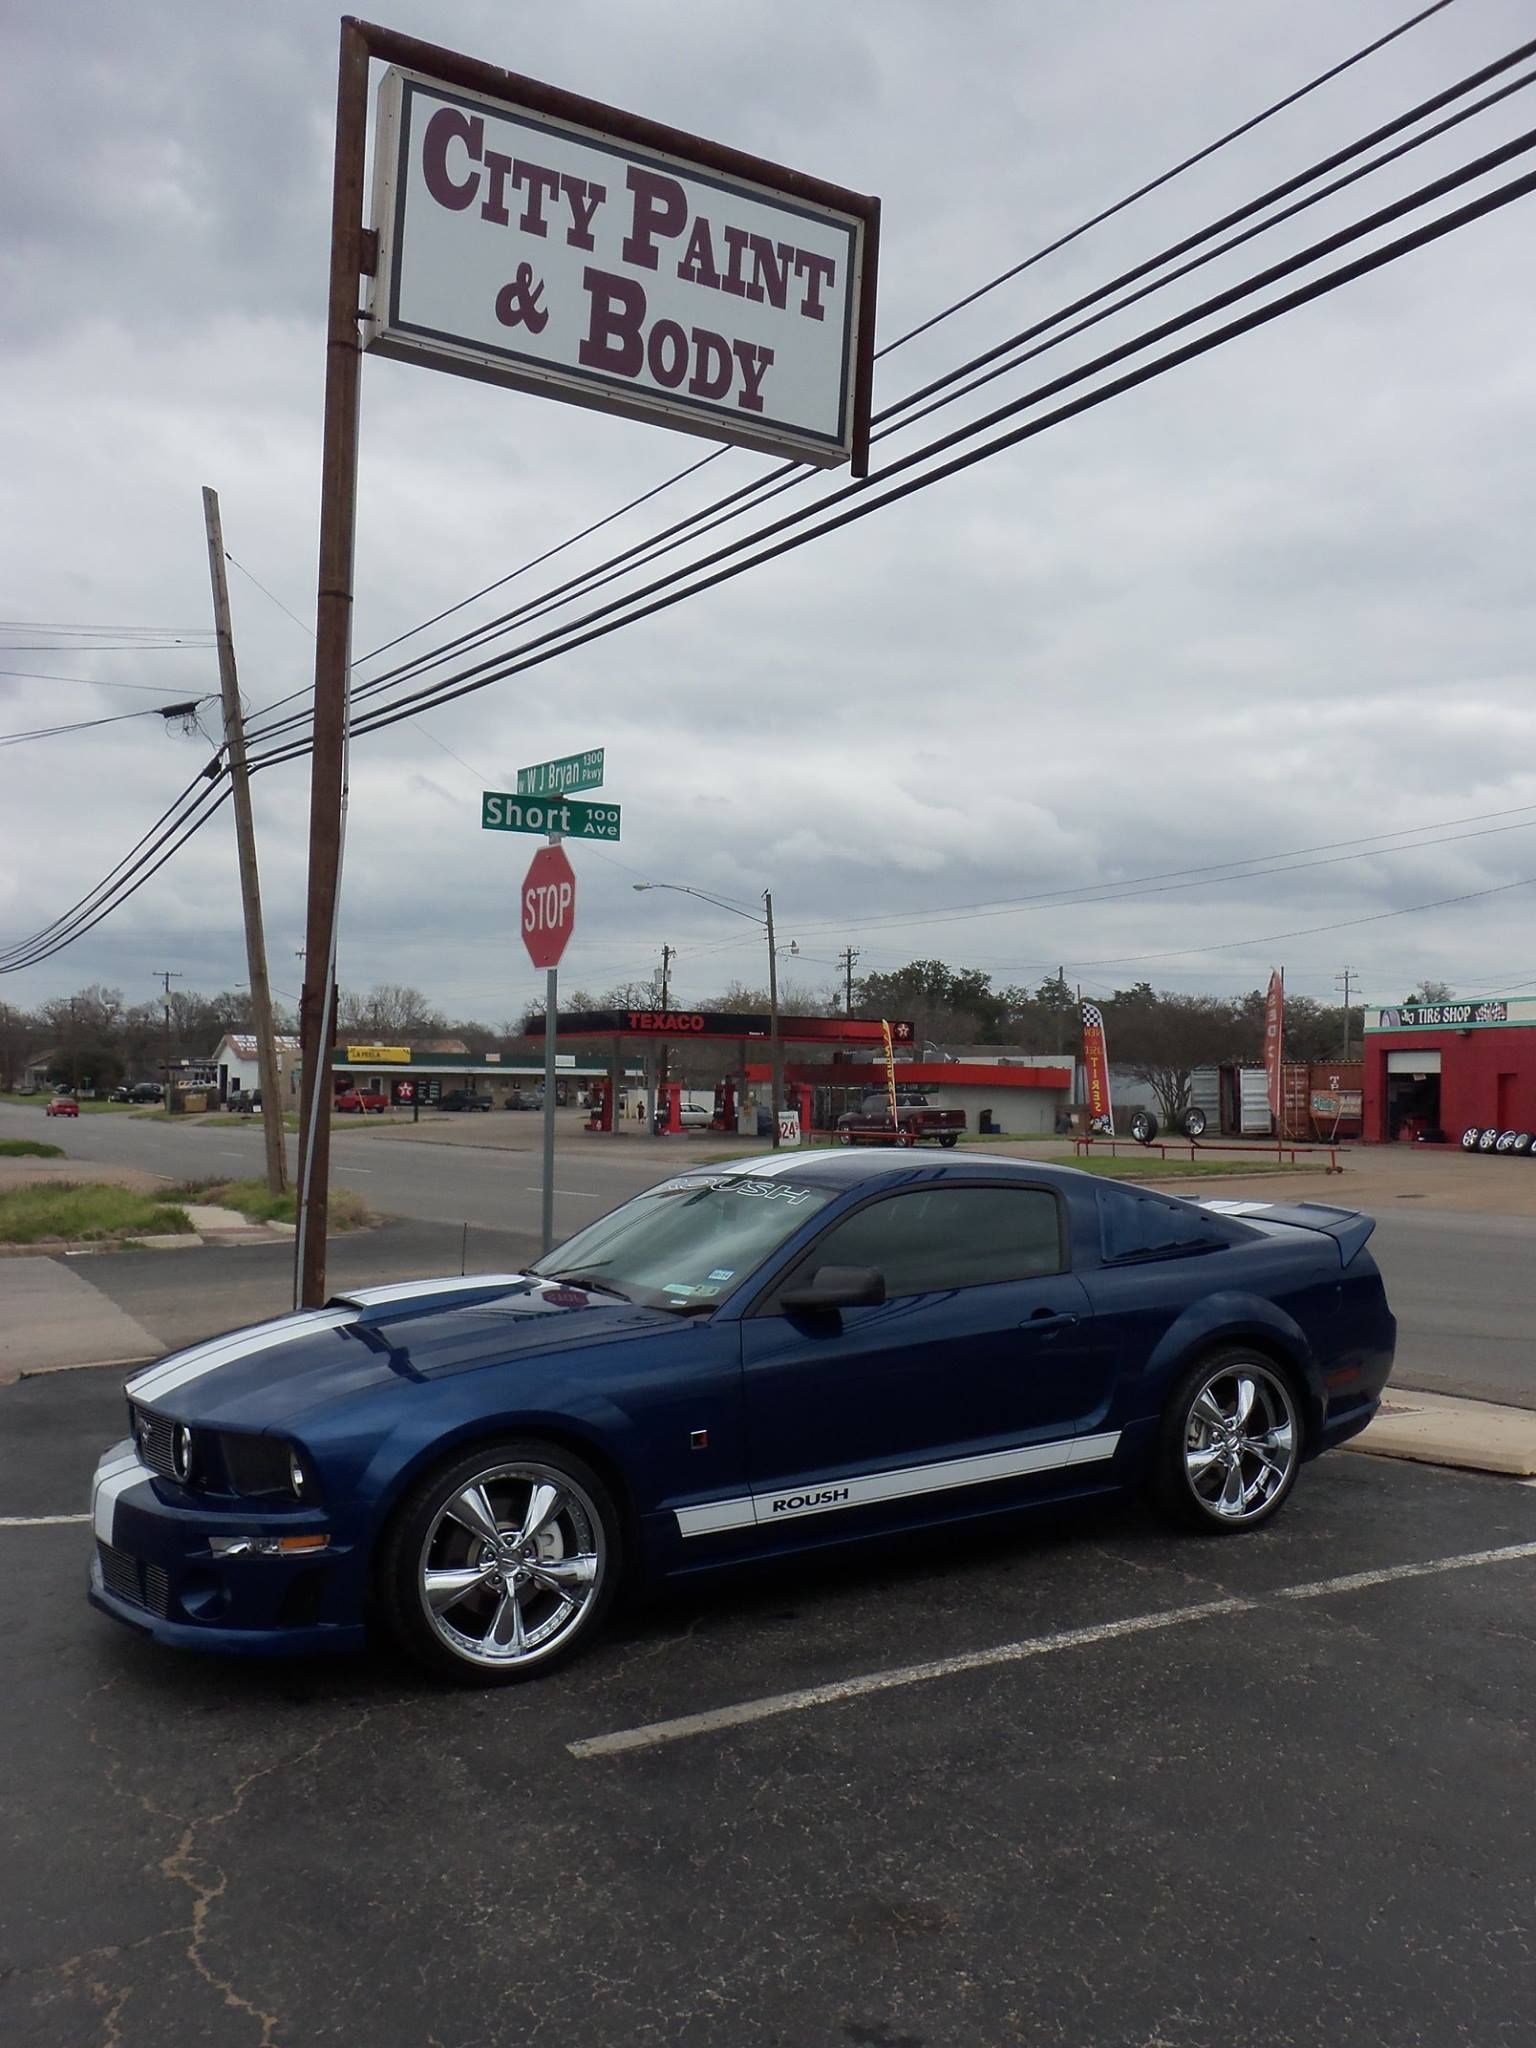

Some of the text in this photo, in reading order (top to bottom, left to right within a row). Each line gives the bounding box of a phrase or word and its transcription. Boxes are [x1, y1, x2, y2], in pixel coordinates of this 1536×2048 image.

[422, 107, 836, 321] CITY PAINT
[495, 261, 775, 412] & BODY
[583, 751, 603, 766] 1300
[527, 767, 536, 794] W
[539, 765, 545, 791] J
[548, 762, 580, 793] Bryan
[582, 768, 603, 782] Pkwy
[486, 797, 571, 832] Short
[586, 808, 618, 823] 100
[583, 822, 618, 836] Ave
[524, 882, 572, 933] STOP
[628, 1012, 705, 1031] TEXACO
[1418, 1006, 1441, 1024] TIRE
[1442, 1005, 1471, 1023] SHOP
[772, 1488, 849, 1513] ROUSH
